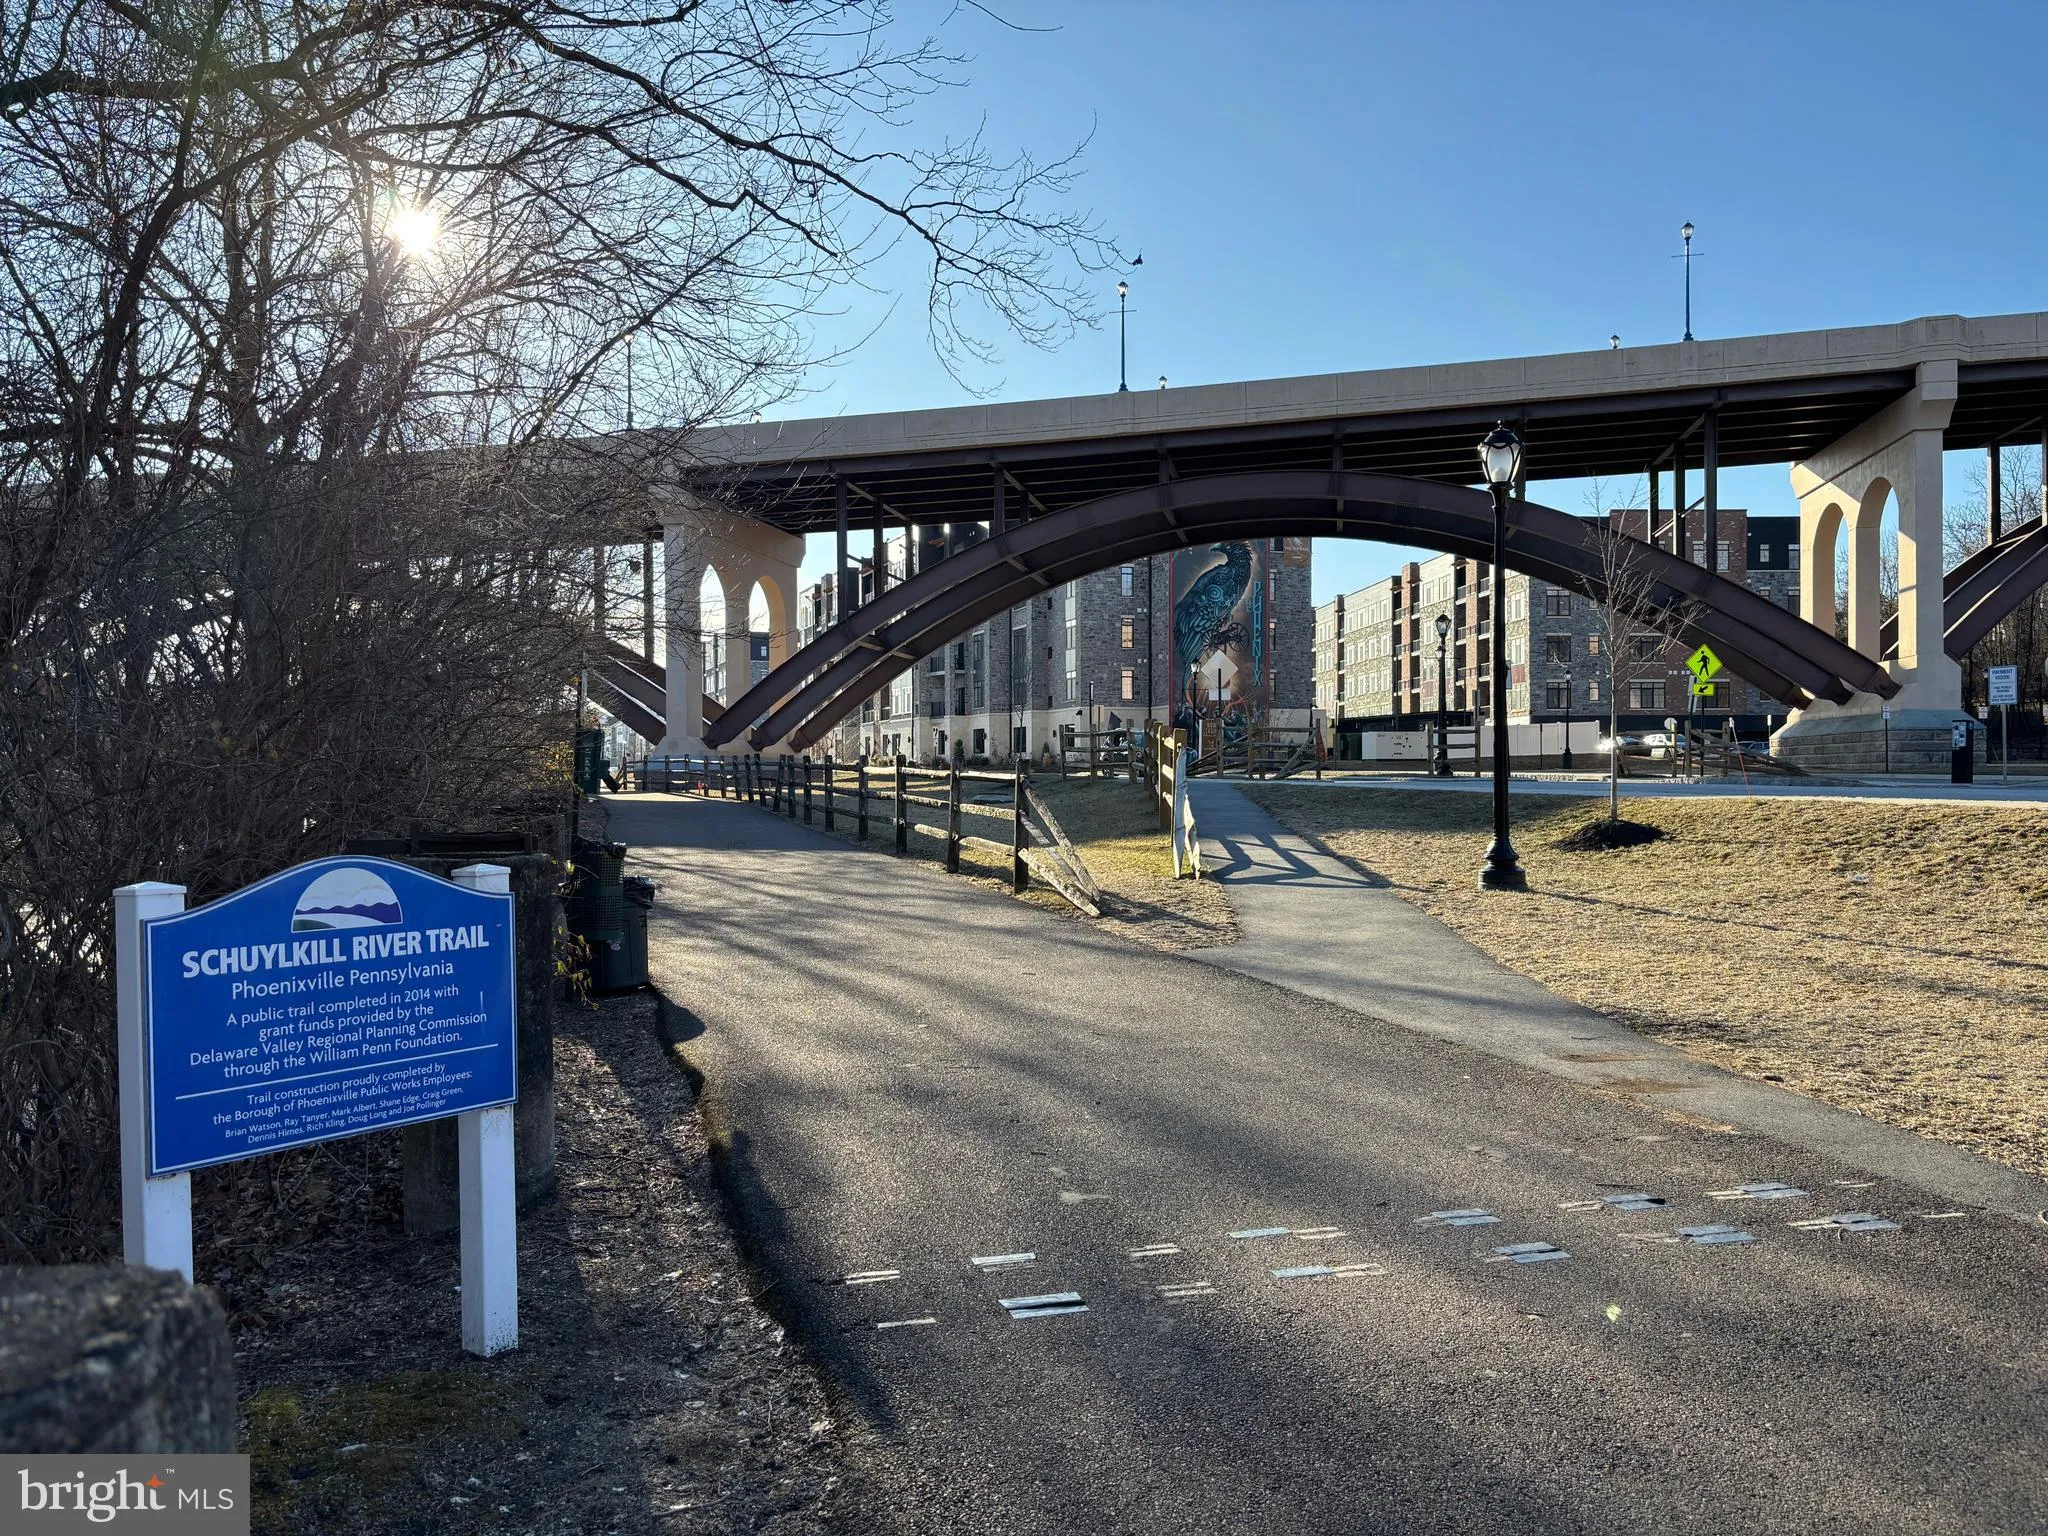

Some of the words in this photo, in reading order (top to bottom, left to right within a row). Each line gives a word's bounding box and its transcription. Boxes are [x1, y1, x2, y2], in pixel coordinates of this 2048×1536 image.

[182, 938, 347, 978] SCHUYLKILL
[353, 931, 422, 961] RIVER
[426, 925, 490, 953] TRAIL
[232, 970, 345, 1000] Phoenixville
[350, 960, 454, 985] Pennsylvania
[226, 1013, 238, 1026] A
[241, 1007, 284, 1028] public
[288, 1001, 315, 1018] trail
[319, 993, 387, 1014] completed
[390, 992, 401, 1004] in
[404, 988, 431, 1003] 2014
[434, 984, 459, 998] with
[259, 1023, 295, 1042] grant
[298, 1016, 335, 1033] funds
[338, 1008, 394, 1031] provided
[397, 1006, 412, 1021] by
[415, 1004, 434, 1017] the
[190, 1049, 258, 1066] Delaware
[262, 1038, 304, 1054] Valley
[307, 1028, 363, 1049] Regional
[366, 1023, 416, 1040] Planning
[419, 1012, 487, 1031] Commission
[224, 1057, 280, 1078] through
[283, 1054, 306, 1068] the
[310, 1047, 359, 1064] William
[362, 1042, 392, 1056] Penn
[395, 1031, 463, 1051] Foundation.
[213, 1112, 232, 1125] the
[235, 1103, 281, 1121] Borough
[283, 1099, 296, 1112] of
[297, 1087, 358, 1109] Phoenixville
[360, 1084, 389, 1098] Public
[391, 1079, 421, 1092] Works
[423, 1071, 473, 1087] Employees:
[247, 1091, 272, 1105] Trail
[274, 1081, 340, 1101] construction
[342, 1073, 380, 1090] proudly
[383, 1063, 433, 1081] completed
[434, 1062, 446, 1073] by
[225, 1128, 247, 1138] Brian
[249, 1122, 283, 1134] Watson,
[284, 1118, 300, 1128] Ray
[331, 1106, 351, 1117] Mark
[379, 1098, 401, 1108] Shane
[422, 1089, 441, 1100] Craig
[248, 1131, 277, 1144] Dennis
[306, 1121, 324, 1132] Rich
[348, 1112, 369, 1124] Doug
[369, 1108, 388, 1119] Long
[388, 1105, 402, 1115] and
[403, 1103, 415, 1114] Joe
